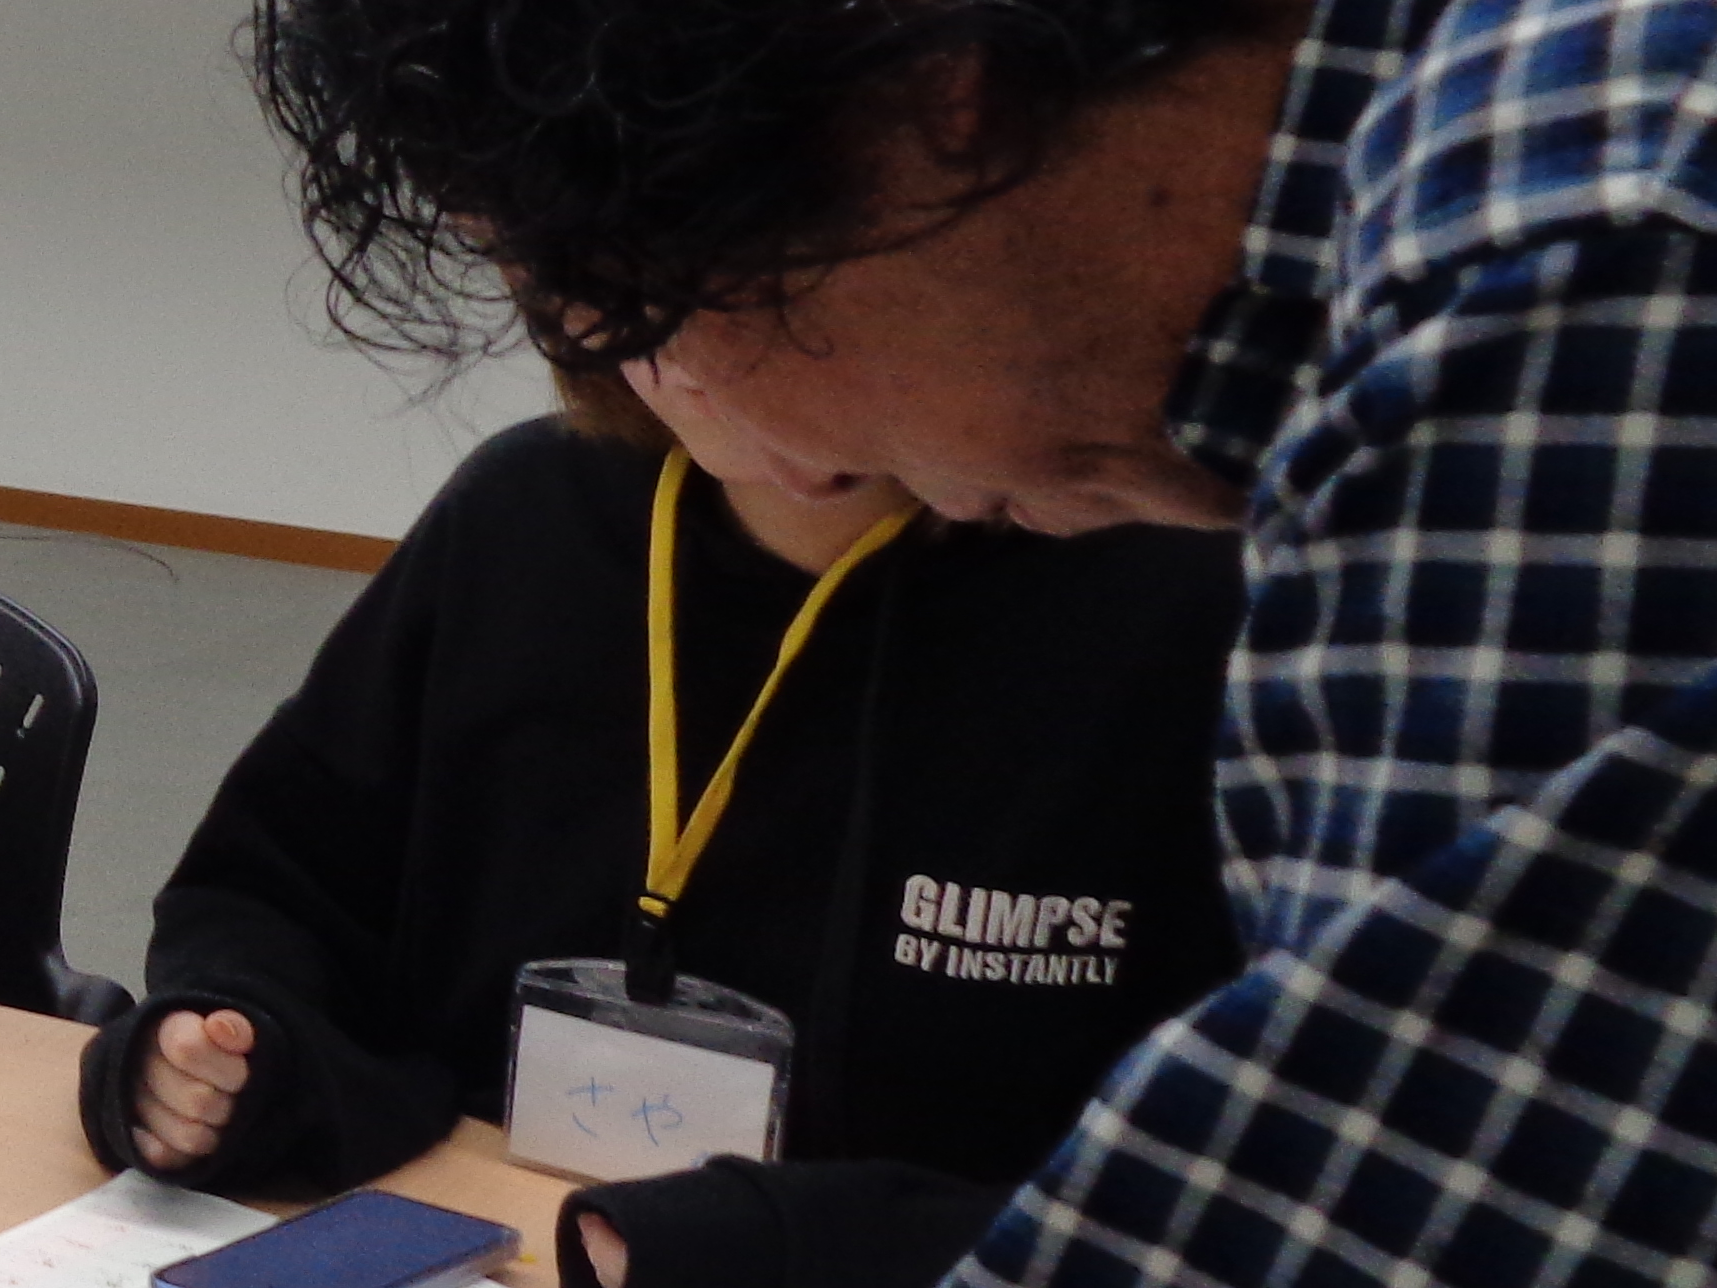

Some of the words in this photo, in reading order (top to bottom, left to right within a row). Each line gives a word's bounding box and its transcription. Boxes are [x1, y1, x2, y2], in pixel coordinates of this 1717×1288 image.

[900, 874, 1132, 949] GLIMPSE
[895, 933, 939, 968] BY
[947, 941, 1119, 986] INSTANTLY
